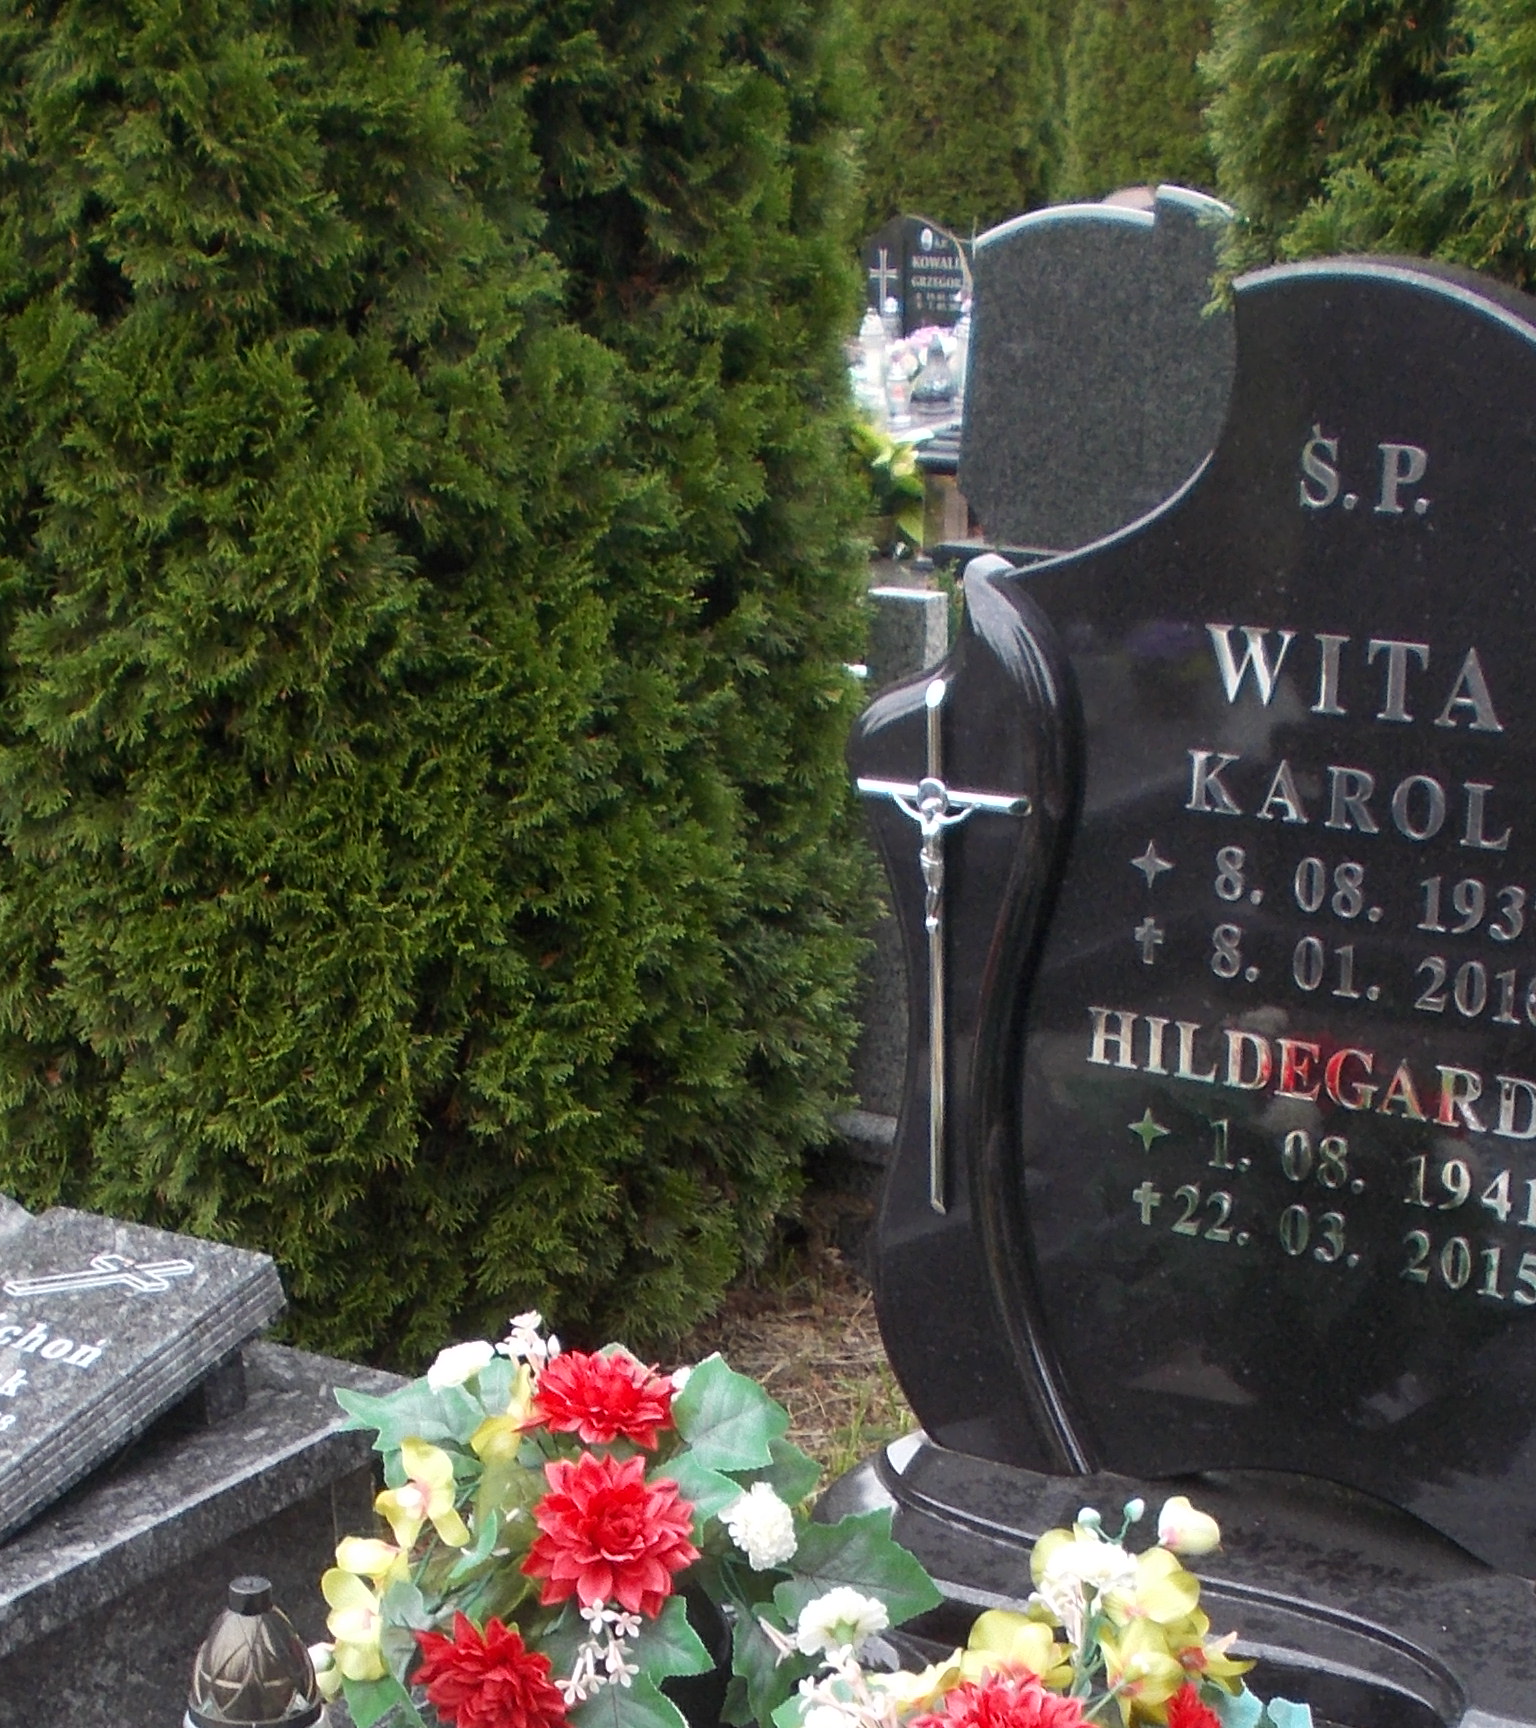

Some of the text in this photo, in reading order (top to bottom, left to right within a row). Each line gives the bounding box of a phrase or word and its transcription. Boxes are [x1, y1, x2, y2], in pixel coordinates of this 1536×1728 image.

[1204, 622, 1504, 733] WITA
[1184, 748, 1511, 852] KAROL
[1213, 845, 1262, 906] 8.
[1293, 855, 1384, 922] 08.
[1210, 922, 1260, 984] 8.
[1292, 934, 1381, 1001] 01.
[1207, 1117, 1252, 1173] 1.
[1280, 1128, 1365, 1195] 08.
[1170, 1182, 1250, 1247] 22.
[1279, 1203, 1360, 1268] 03.
